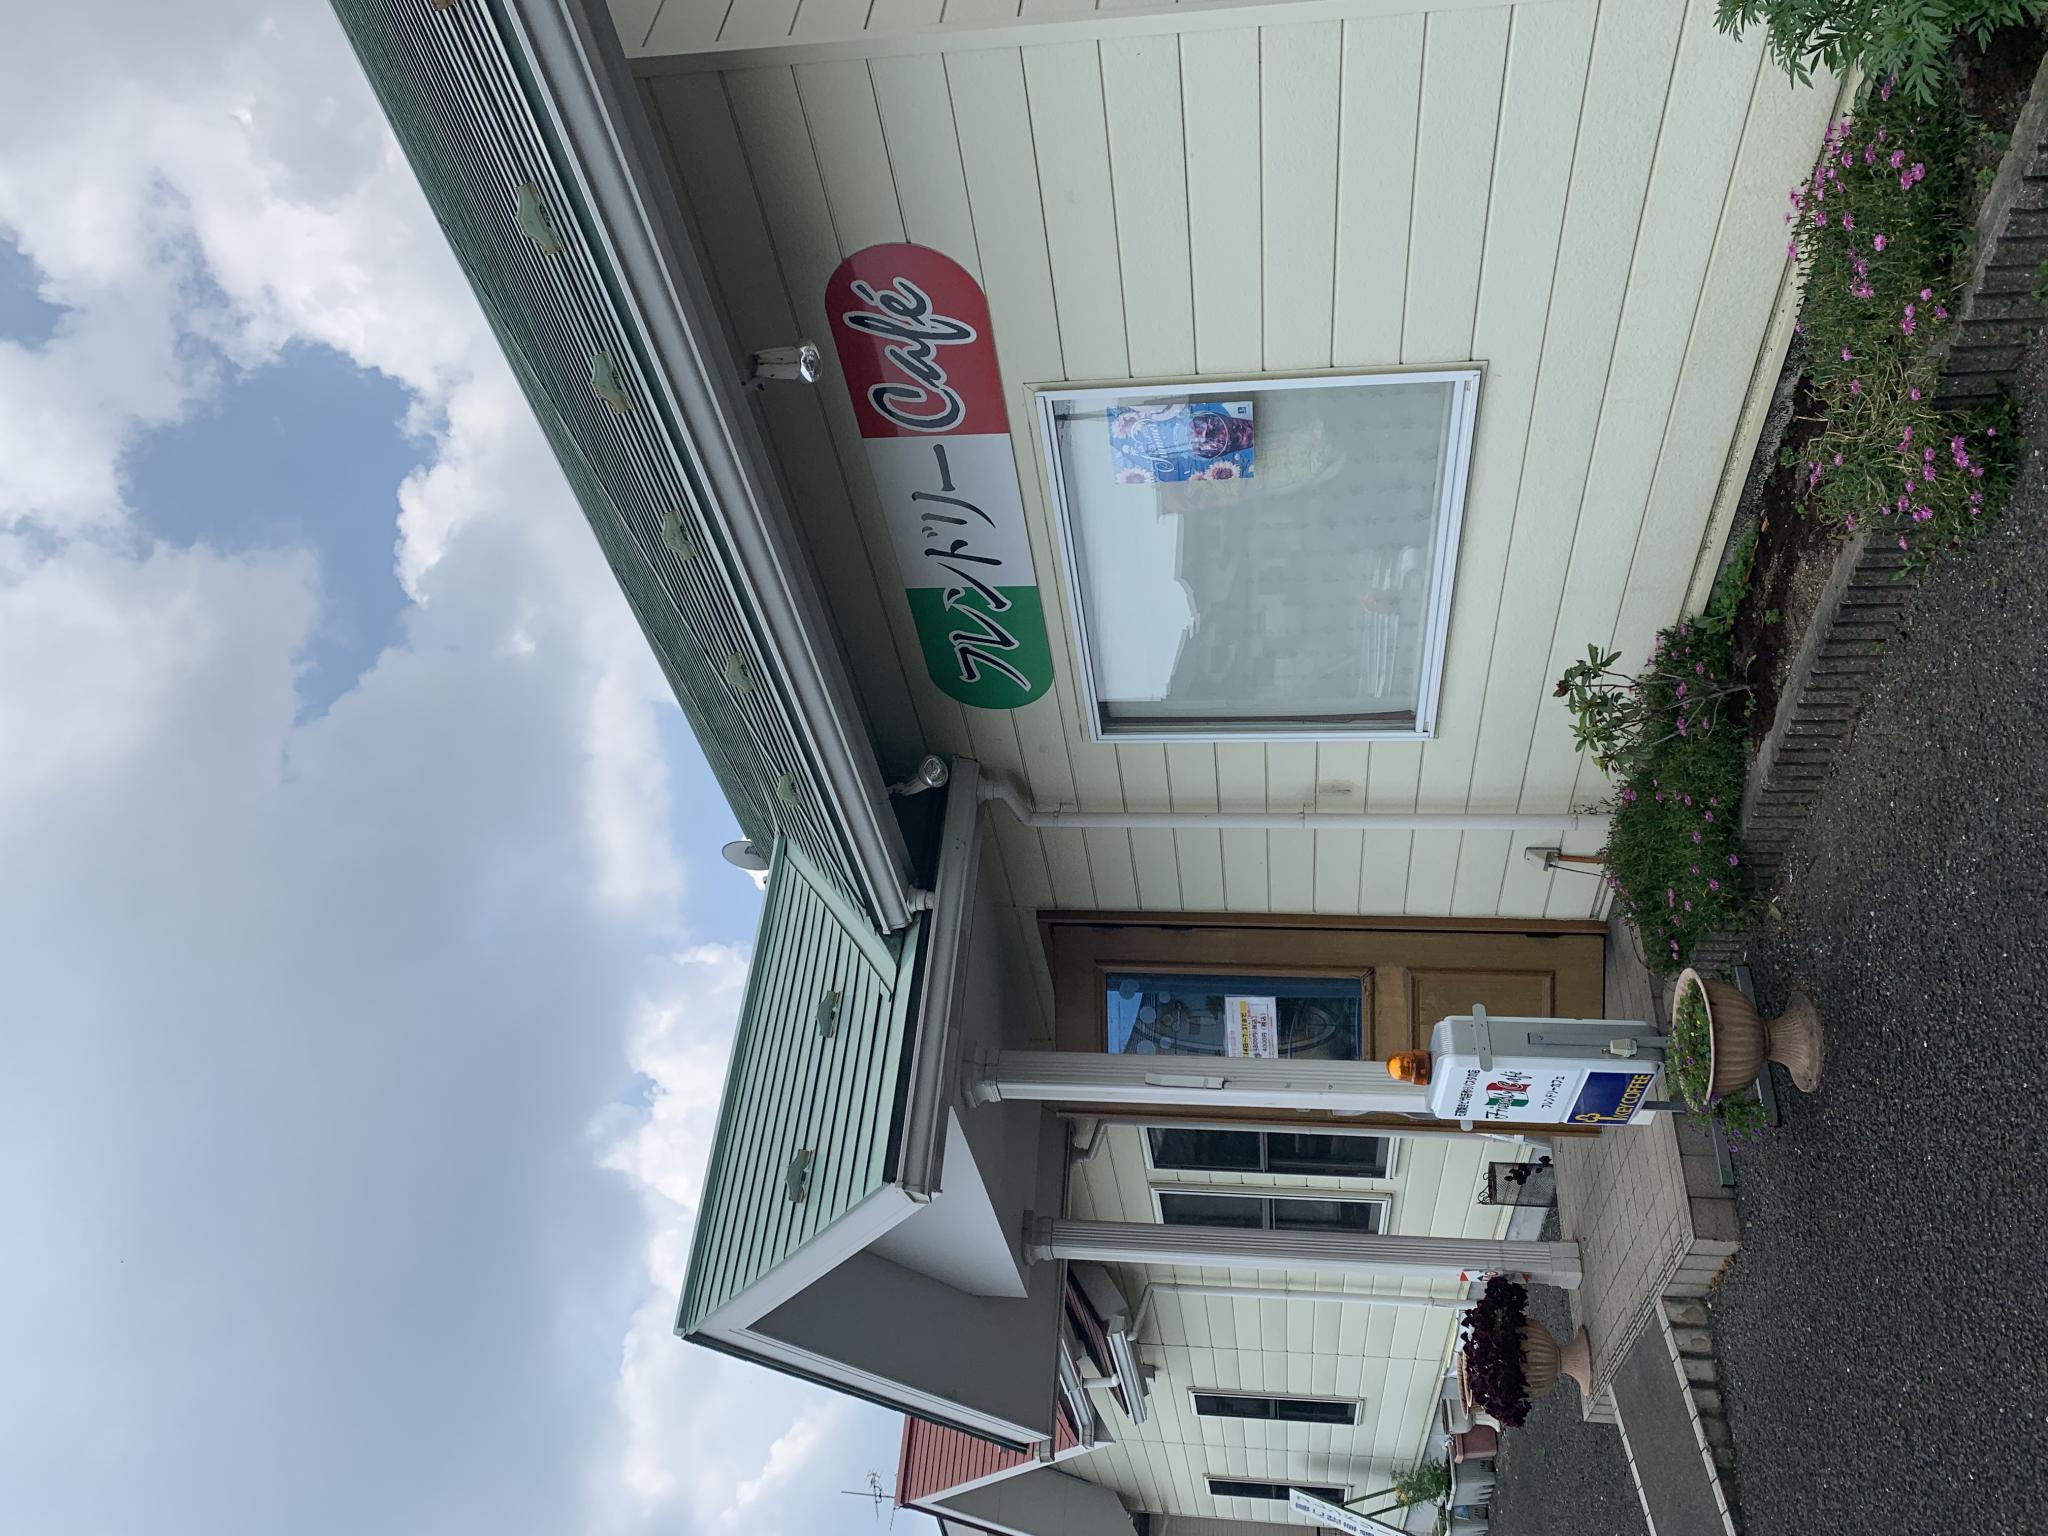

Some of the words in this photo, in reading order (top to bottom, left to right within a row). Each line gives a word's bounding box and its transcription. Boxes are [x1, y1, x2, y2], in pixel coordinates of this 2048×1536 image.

[842, 276, 976, 433] Café
[1134, 420, 1175, 472] Summer
[911, 443, 1032, 692] フレンドリー
[1497, 1070, 1533, 1090] Café
[1541, 1075, 1565, 1109] フレンドリーカフェ
[1623, 1074, 1652, 1104] COFFEE
[1485, 1090, 1526, 1120] Friendly
[1614, 1102, 1635, 1118] KEY
